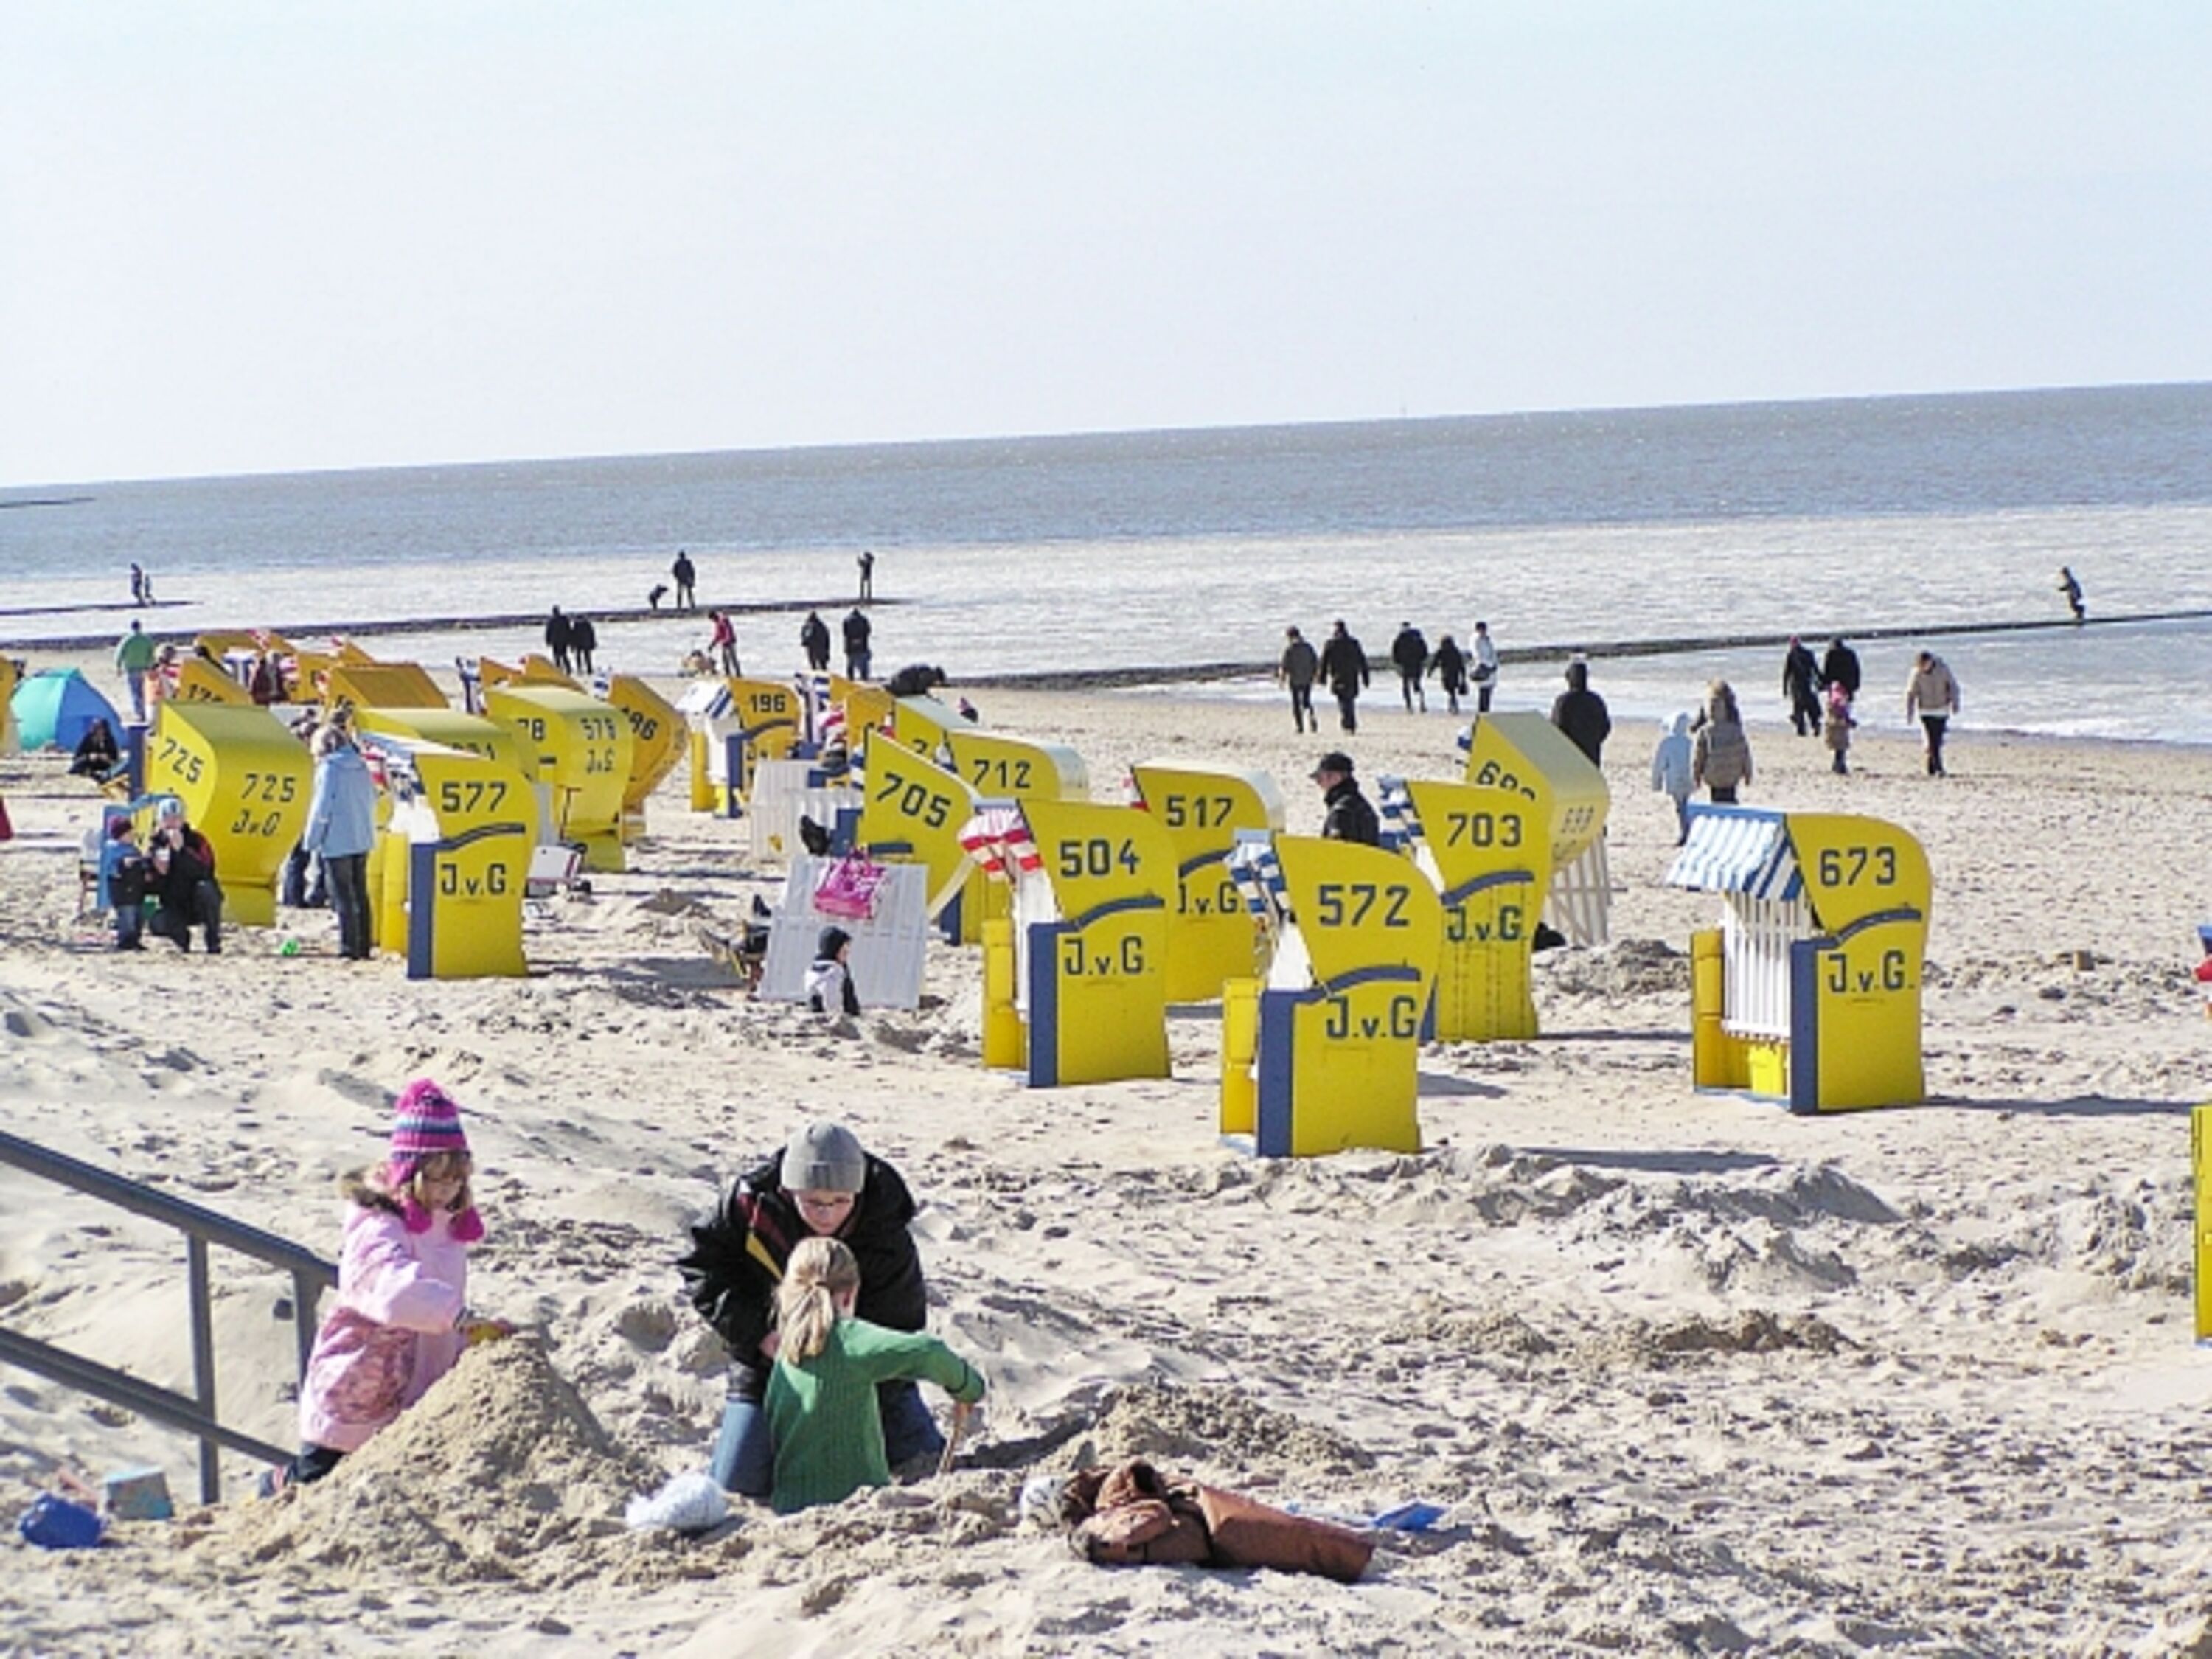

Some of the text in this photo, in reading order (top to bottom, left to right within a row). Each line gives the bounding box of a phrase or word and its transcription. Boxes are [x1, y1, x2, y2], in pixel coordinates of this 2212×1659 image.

[750, 694, 785, 713] 196
[159, 737, 204, 783] 725
[973, 759, 1031, 789] 712
[241, 773, 296, 802] 725
[442, 781, 506, 813] 577
[876, 771, 951, 827] 705
[1166, 795, 1233, 827] 517
[1448, 813, 1522, 848] 703
[1060, 838, 1140, 877] 504
[1820, 846, 1896, 888] 673
[1319, 884, 1410, 927] 572
